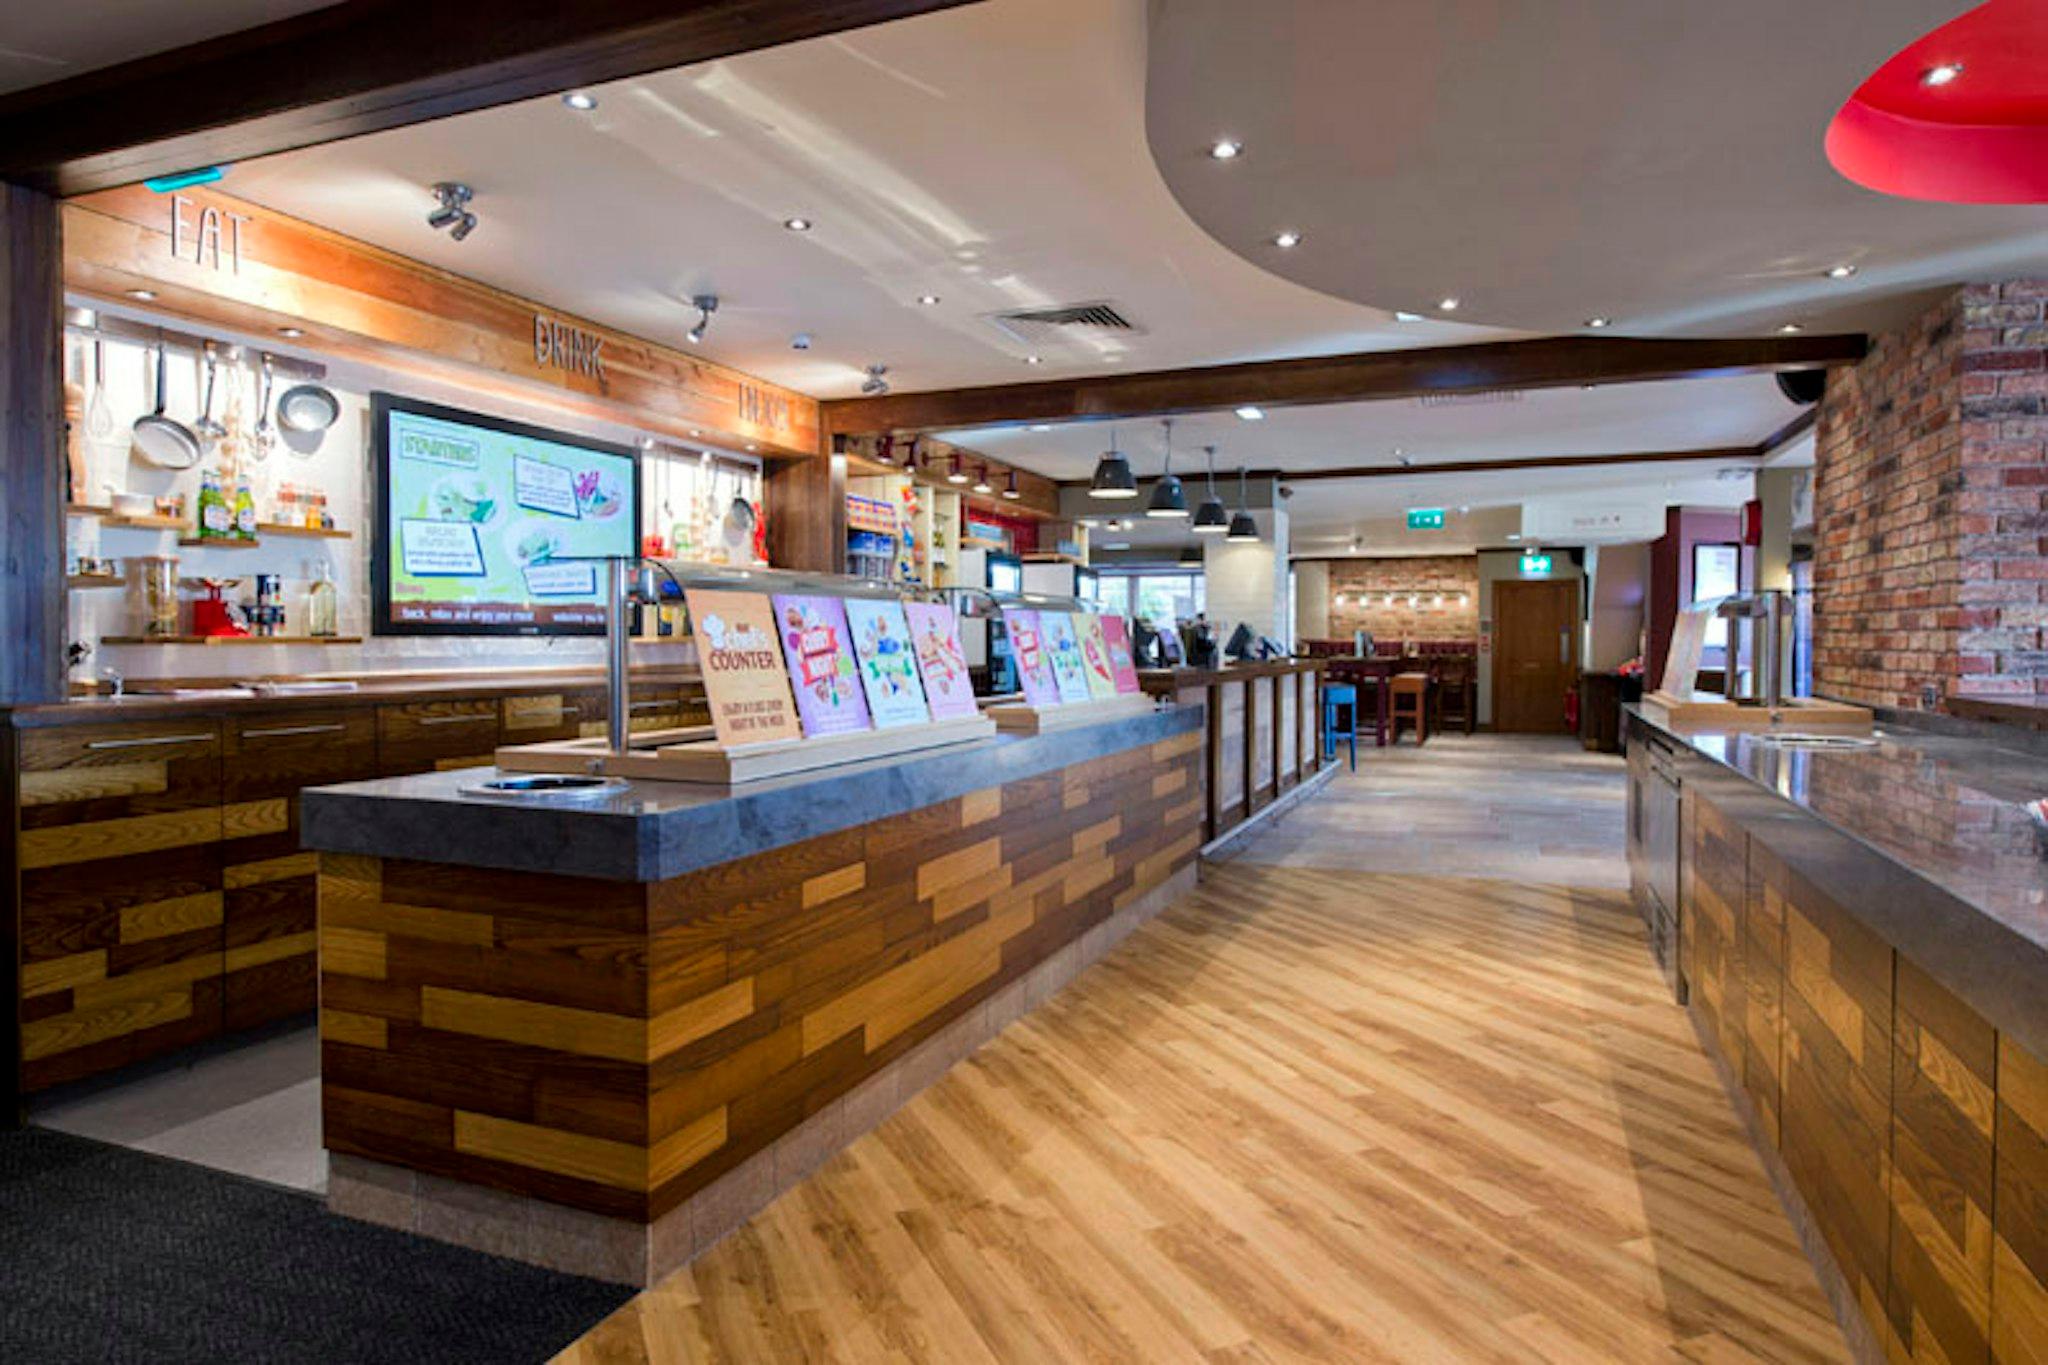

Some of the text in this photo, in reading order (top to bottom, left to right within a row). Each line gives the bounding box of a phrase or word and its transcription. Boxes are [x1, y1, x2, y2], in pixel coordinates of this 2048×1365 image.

[171, 193, 252, 274] EAT
[533, 312, 607, 384] DRINK
[709, 650, 775, 671] COUNTER
